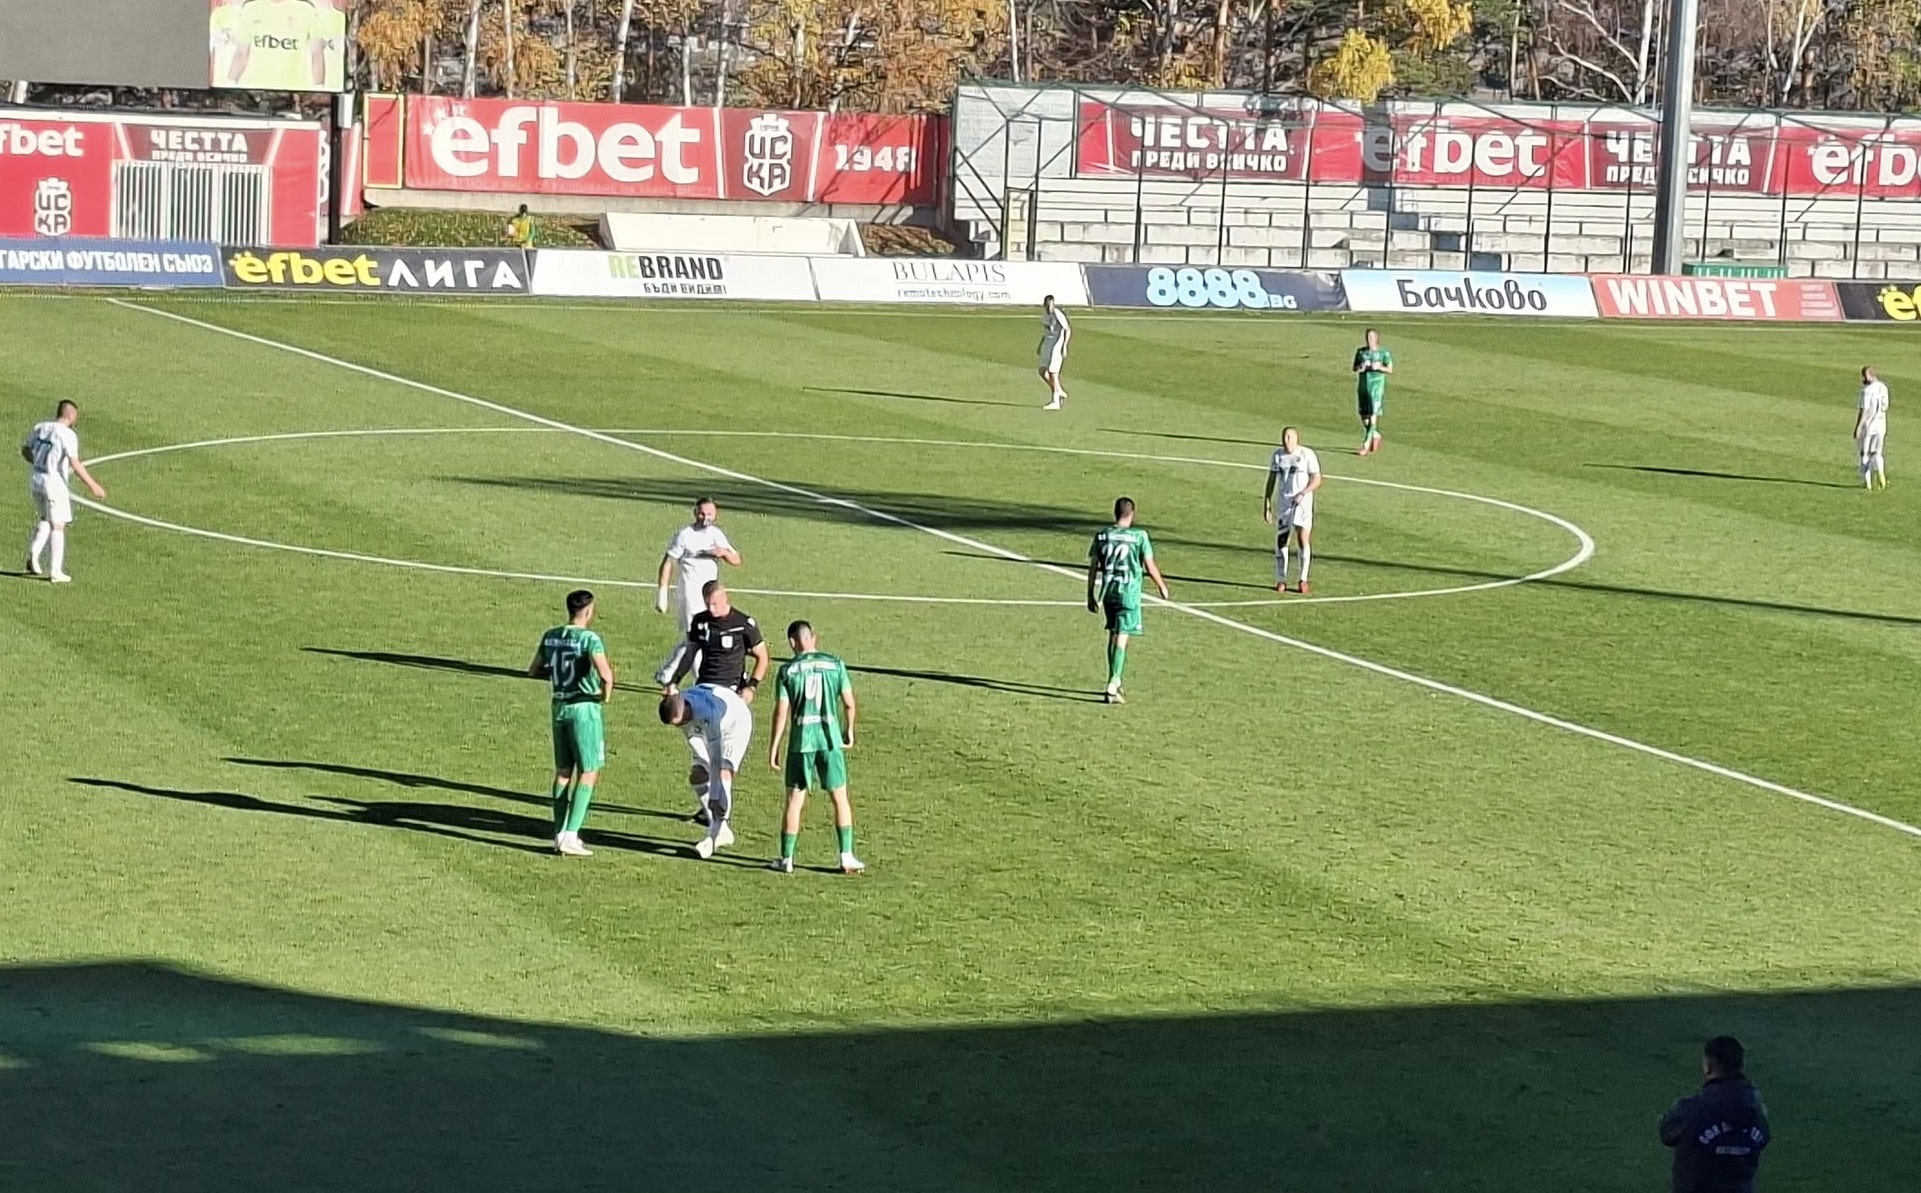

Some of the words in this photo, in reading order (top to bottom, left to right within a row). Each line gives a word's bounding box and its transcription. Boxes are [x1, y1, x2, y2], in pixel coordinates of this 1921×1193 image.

[254, 35, 299, 50] efbet
[150, 129, 248, 152] ЧЕСТТА
[431, 106, 701, 184] efbet
[1130, 115, 1288, 152] ЧЕСТТА
[1606, 129, 1751, 166] ЧЕТТА
[1131, 150, 1201, 171] ПРЕДИ
[66, 250, 161, 273] ФУТБОЛЕН
[163, 253, 213, 273] СЪЮЗ
[234, 252, 381, 286] efbet
[387, 258, 522, 288] ЛИГА
[1396, 277, 1547, 311] Бачково
[1607, 279, 1777, 317] WINBET
